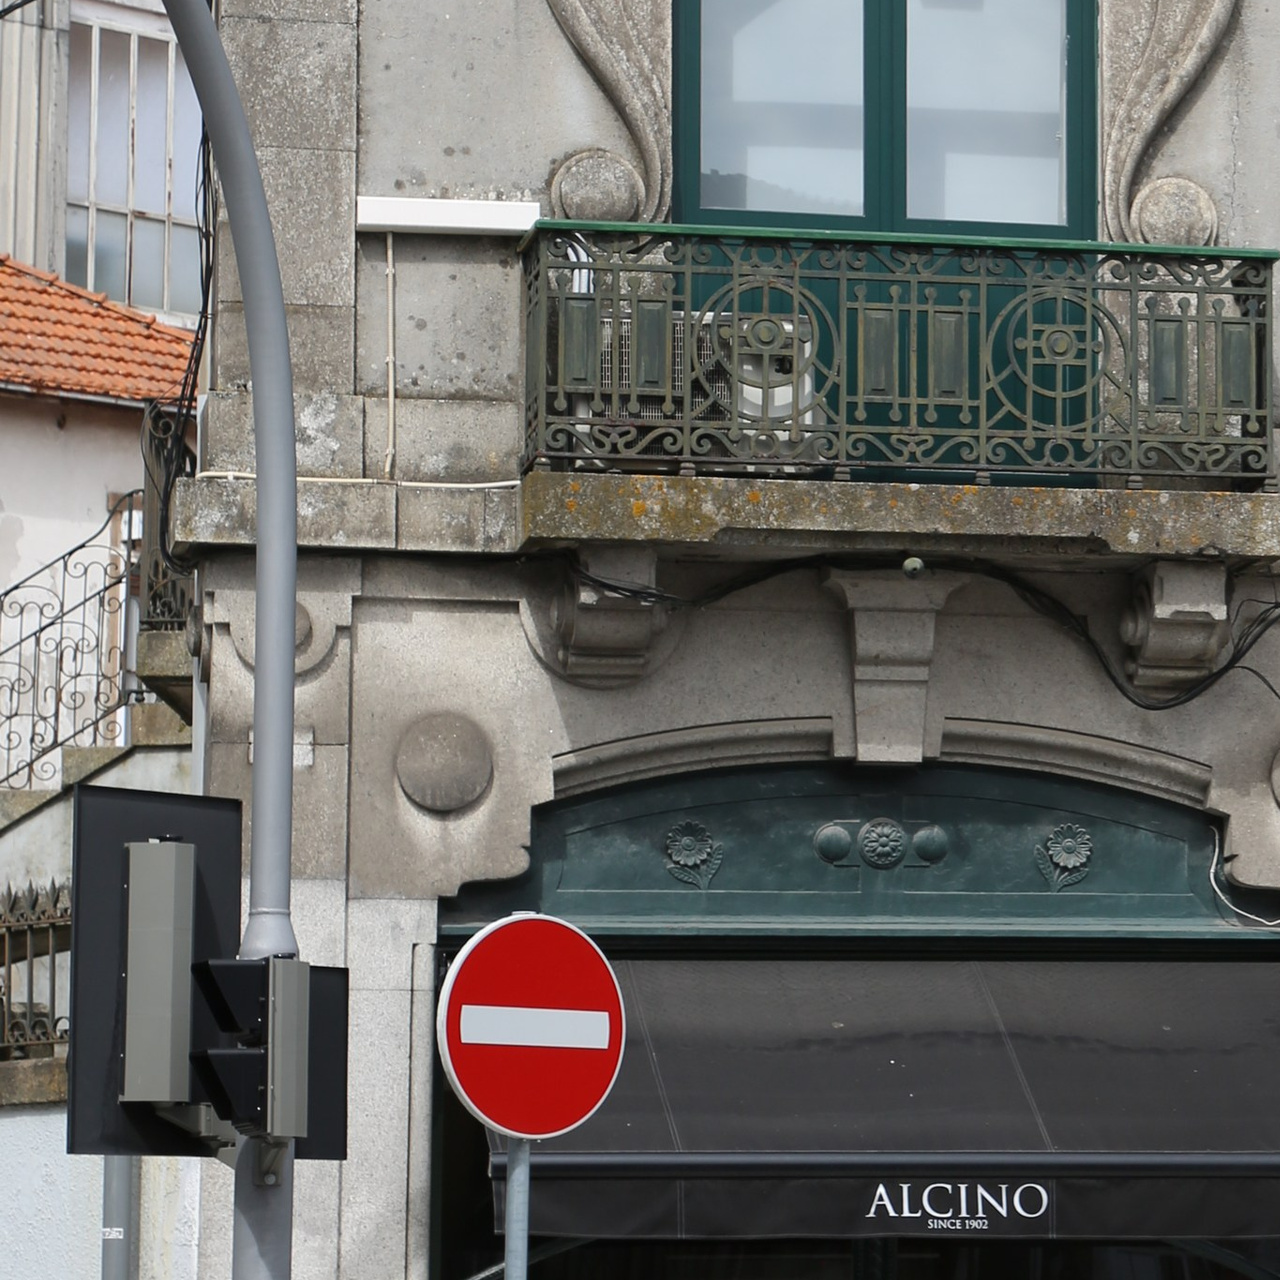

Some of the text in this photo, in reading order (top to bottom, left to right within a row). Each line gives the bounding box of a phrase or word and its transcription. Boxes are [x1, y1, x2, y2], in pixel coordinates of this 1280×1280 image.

[865, 1183, 1049, 1218] ALCINO
[927, 1218, 989, 1230] SINCE 1902
